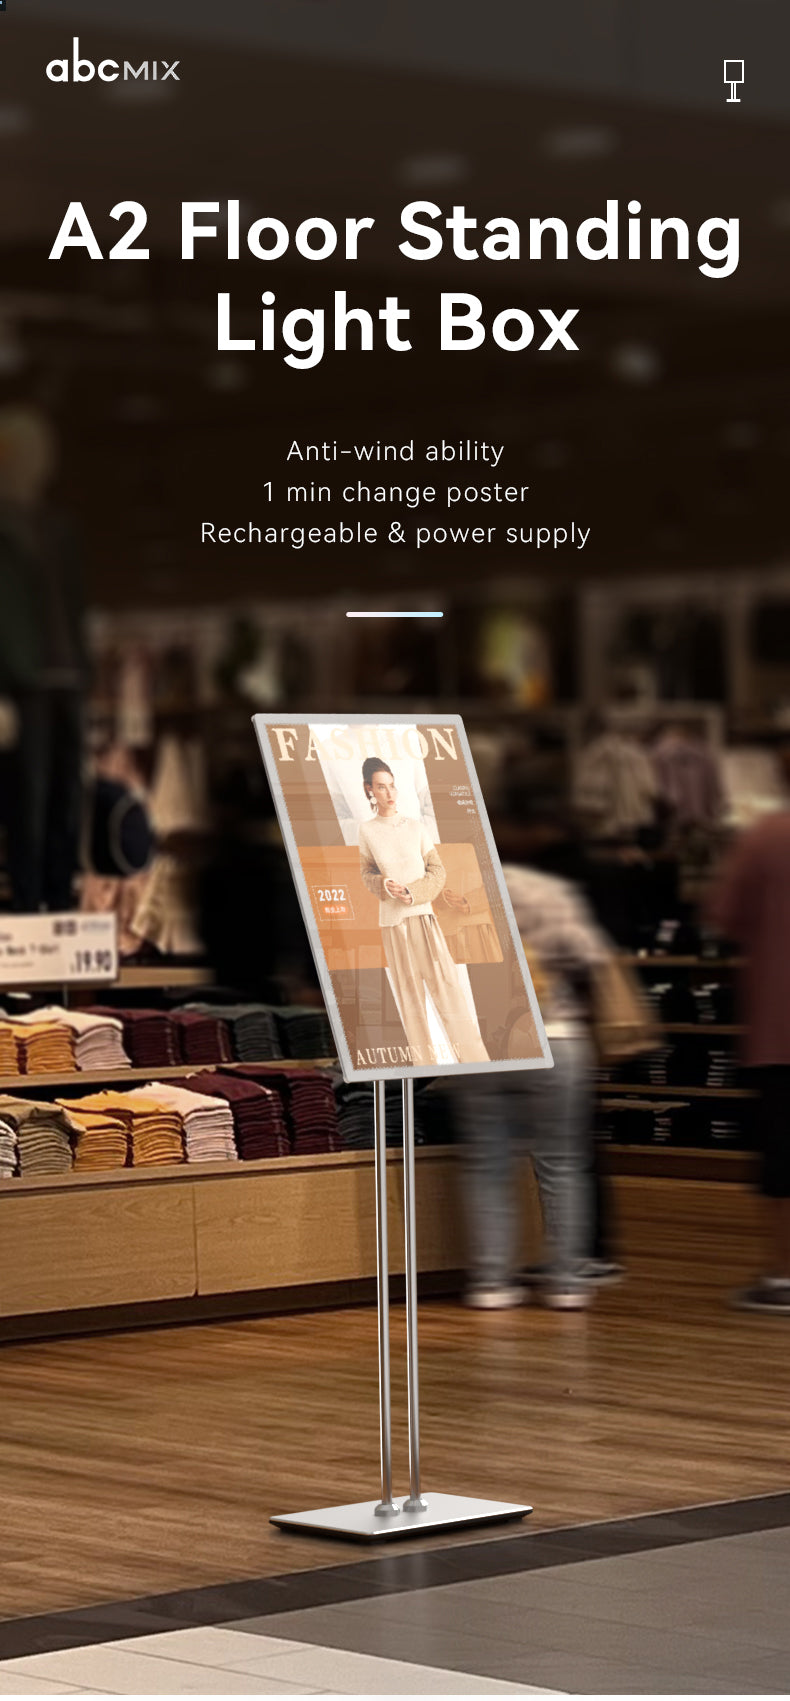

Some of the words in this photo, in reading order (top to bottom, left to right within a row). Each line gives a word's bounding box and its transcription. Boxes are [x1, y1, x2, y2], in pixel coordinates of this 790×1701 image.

[271, 727, 458, 762] FASHION
[317, 888, 347, 902] 2022
[356, 1045, 423, 1066] AUTUMN
